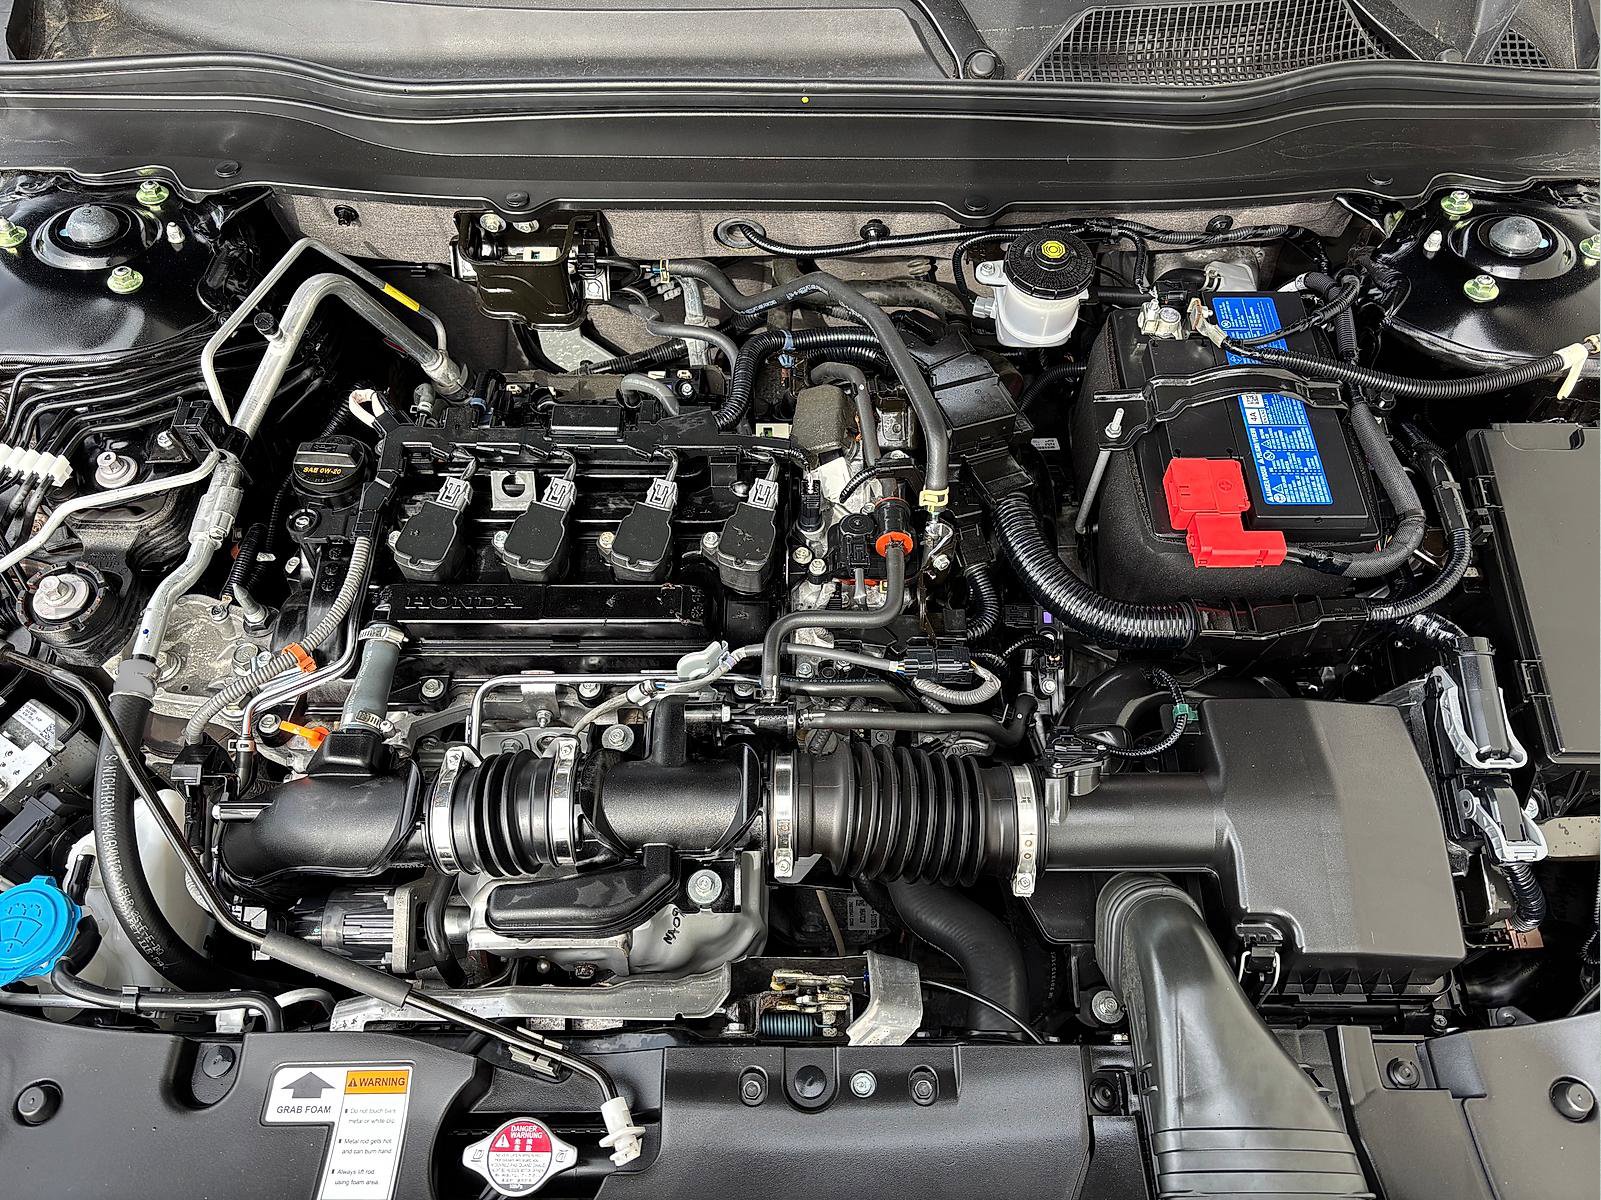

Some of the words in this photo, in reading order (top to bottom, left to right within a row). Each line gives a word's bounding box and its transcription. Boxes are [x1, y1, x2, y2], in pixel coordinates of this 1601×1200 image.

[319, 467, 342, 475] 0W-20
[405, 596, 523, 610] HONDA
[359, 1077, 406, 1087] WARNING
[276, 1105, 303, 1114] GRAB
[304, 1105, 332, 1114] FOAM
